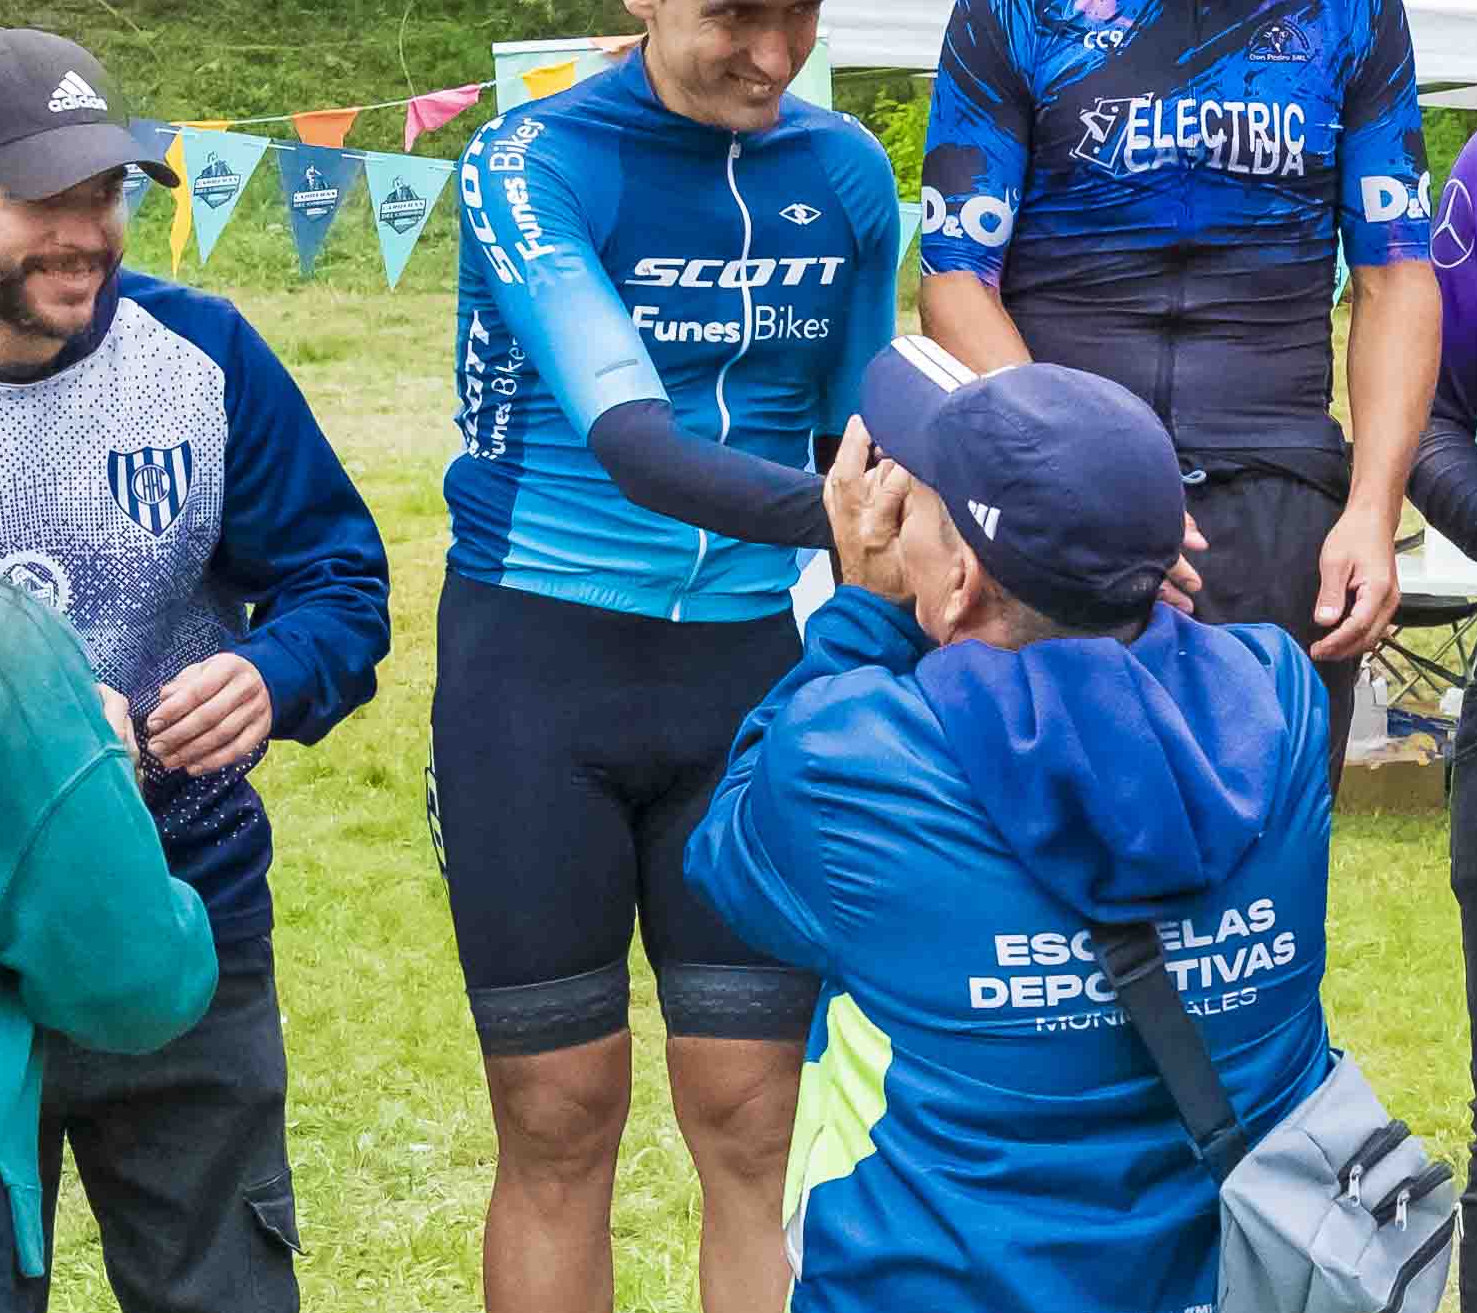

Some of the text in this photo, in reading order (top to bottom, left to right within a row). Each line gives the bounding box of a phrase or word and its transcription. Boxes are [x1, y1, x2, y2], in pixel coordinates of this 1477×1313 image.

[1127, 97, 1305, 155] ELECTRIC
[625, 256, 846, 288] SCOTT
[632, 305, 830, 344] Funes Bikes
[994, 898, 1276, 967] ESCELAS
[969, 931, 1296, 1009] DEPOTIVAS
